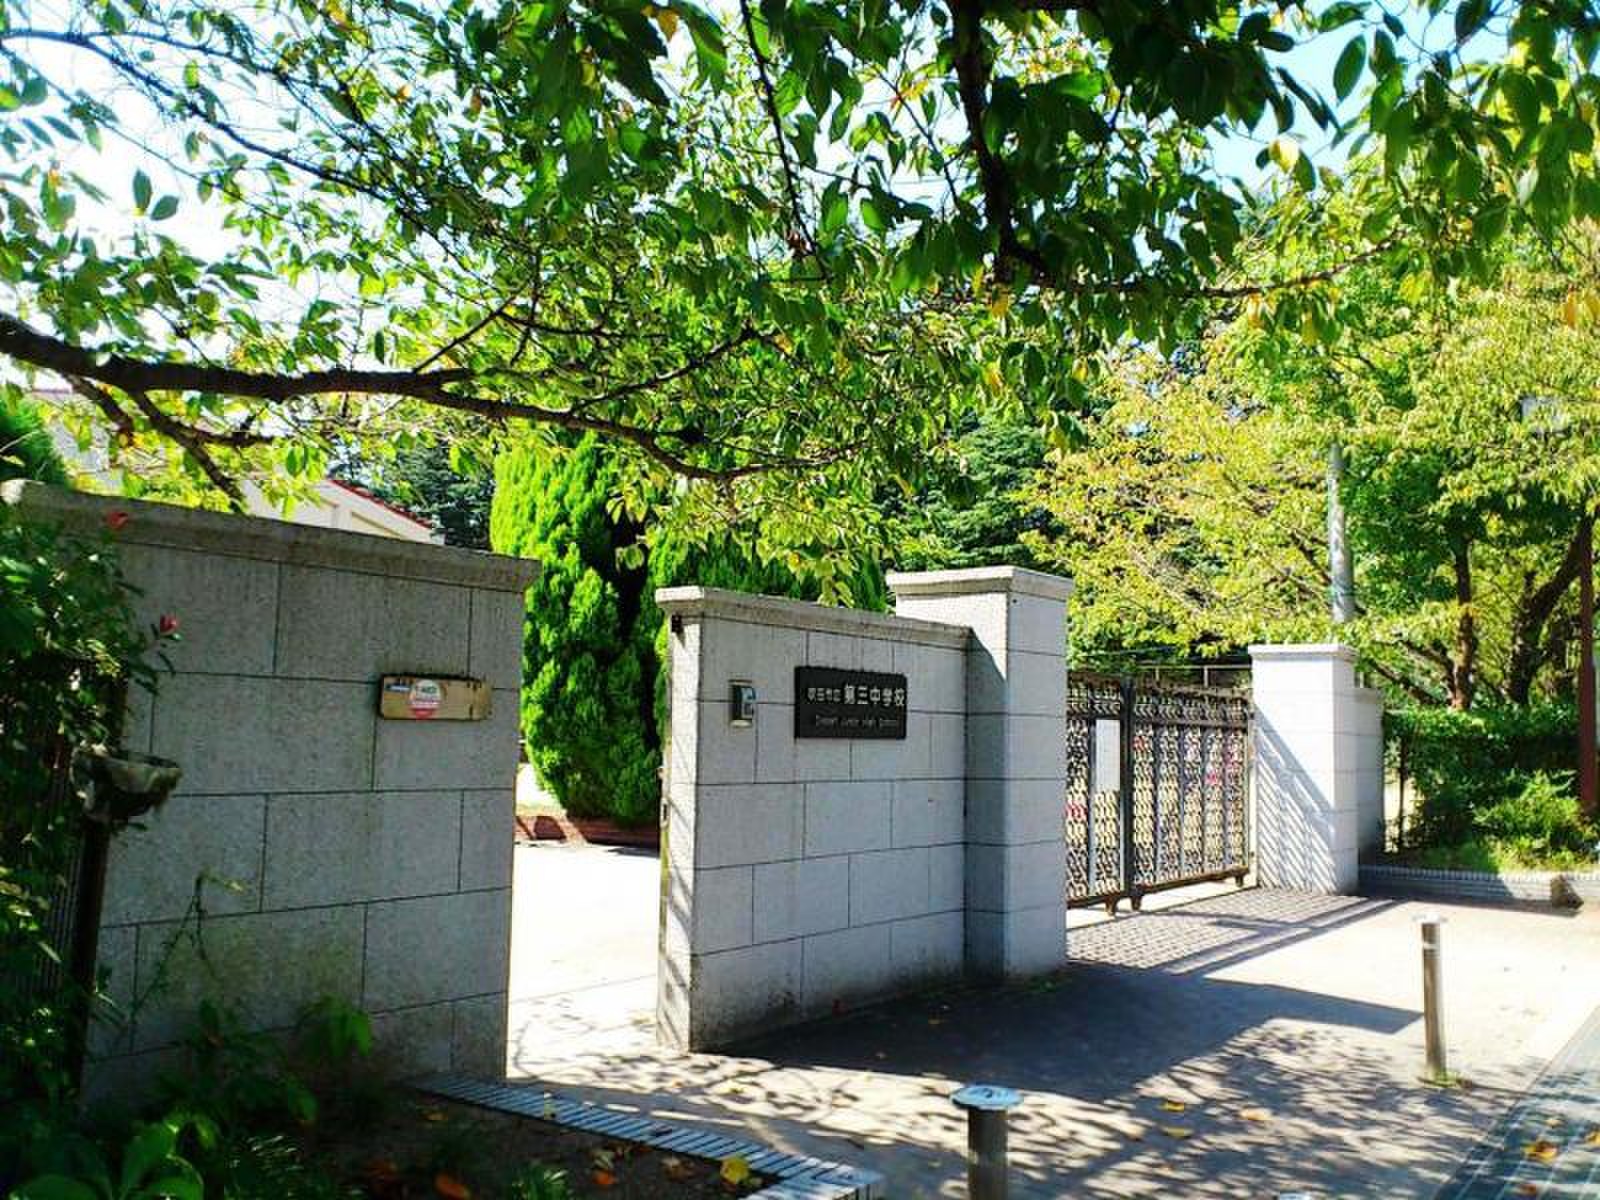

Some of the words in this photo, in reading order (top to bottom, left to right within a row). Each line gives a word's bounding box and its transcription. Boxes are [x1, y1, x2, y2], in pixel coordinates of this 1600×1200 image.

[844, 683, 905, 706] 第三中学校
